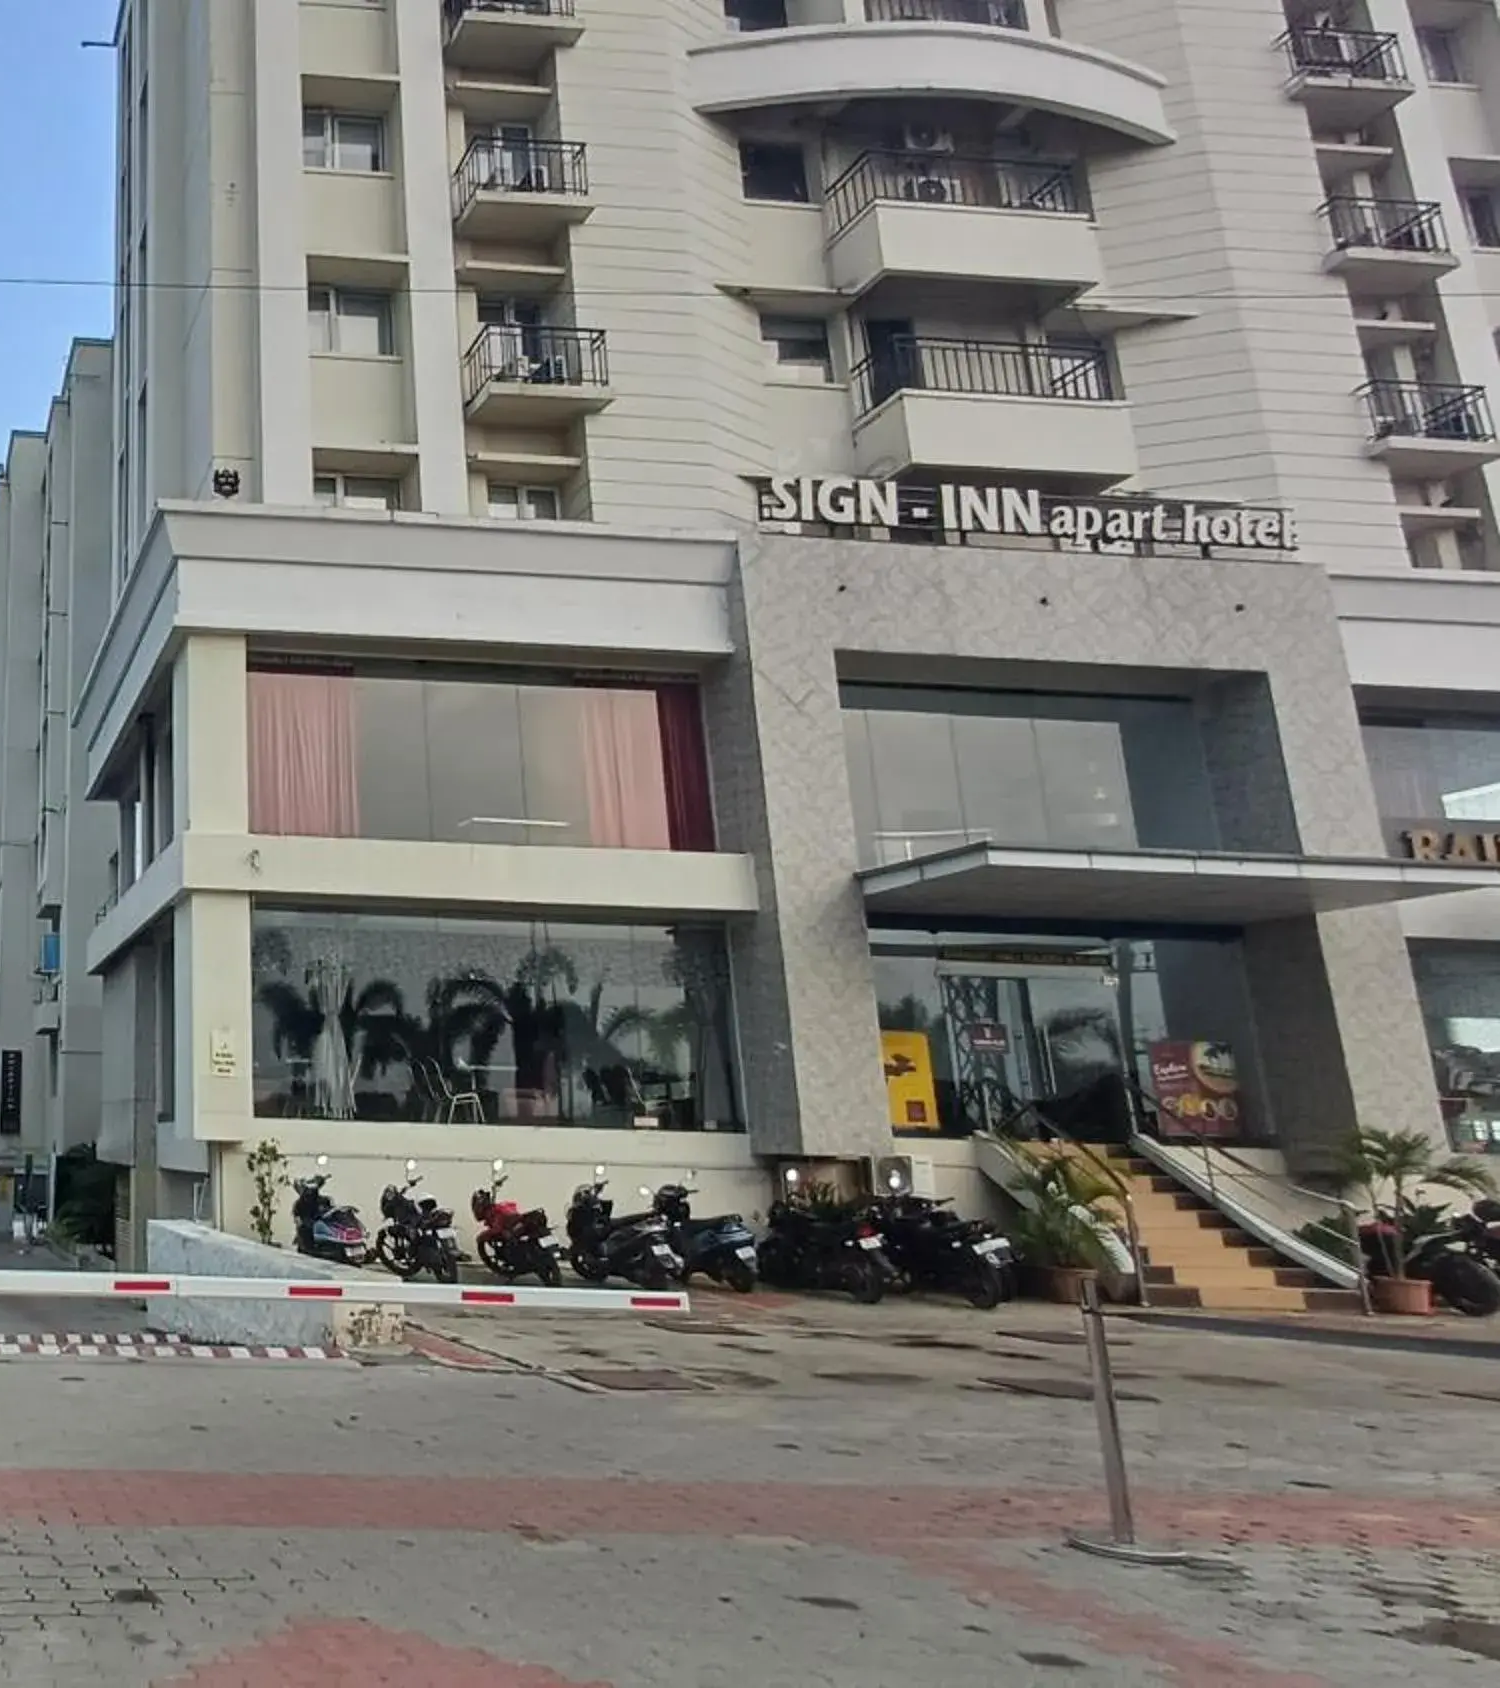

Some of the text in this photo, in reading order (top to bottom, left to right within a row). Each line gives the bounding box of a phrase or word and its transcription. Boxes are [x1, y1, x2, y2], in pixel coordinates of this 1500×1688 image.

[769, 477, 900, 527] SIGN
[941, 482, 1043, 535] INN
[1049, 502, 1299, 550] apart hotel
